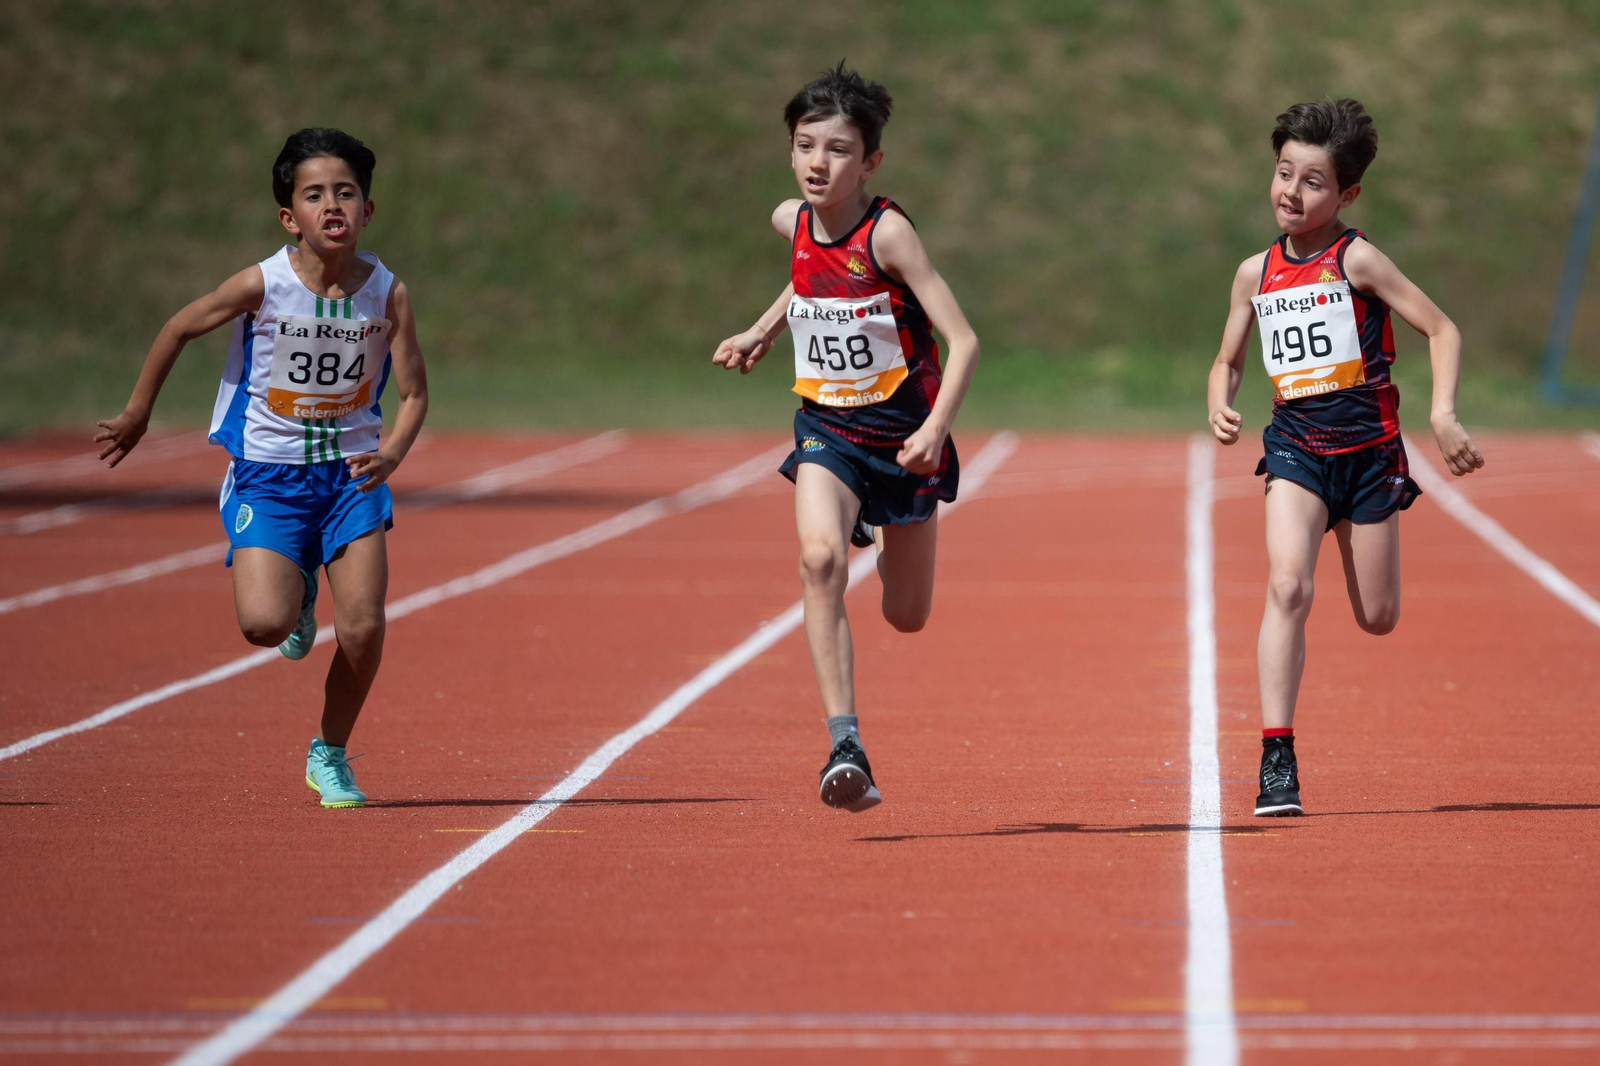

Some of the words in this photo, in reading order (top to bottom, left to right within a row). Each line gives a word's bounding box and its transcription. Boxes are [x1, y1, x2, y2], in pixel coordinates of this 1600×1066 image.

[789, 302, 810, 319] La
[1256, 303, 1273, 318] La
[279, 321, 310, 339] La
[1271, 320, 1333, 365] 496
[807, 334, 874, 371] 458
[288, 351, 365, 386] 384
[817, 391, 884, 406] telemiño
[1280, 380, 1339, 400] telemiño
[293, 404, 355, 418] telemiño
